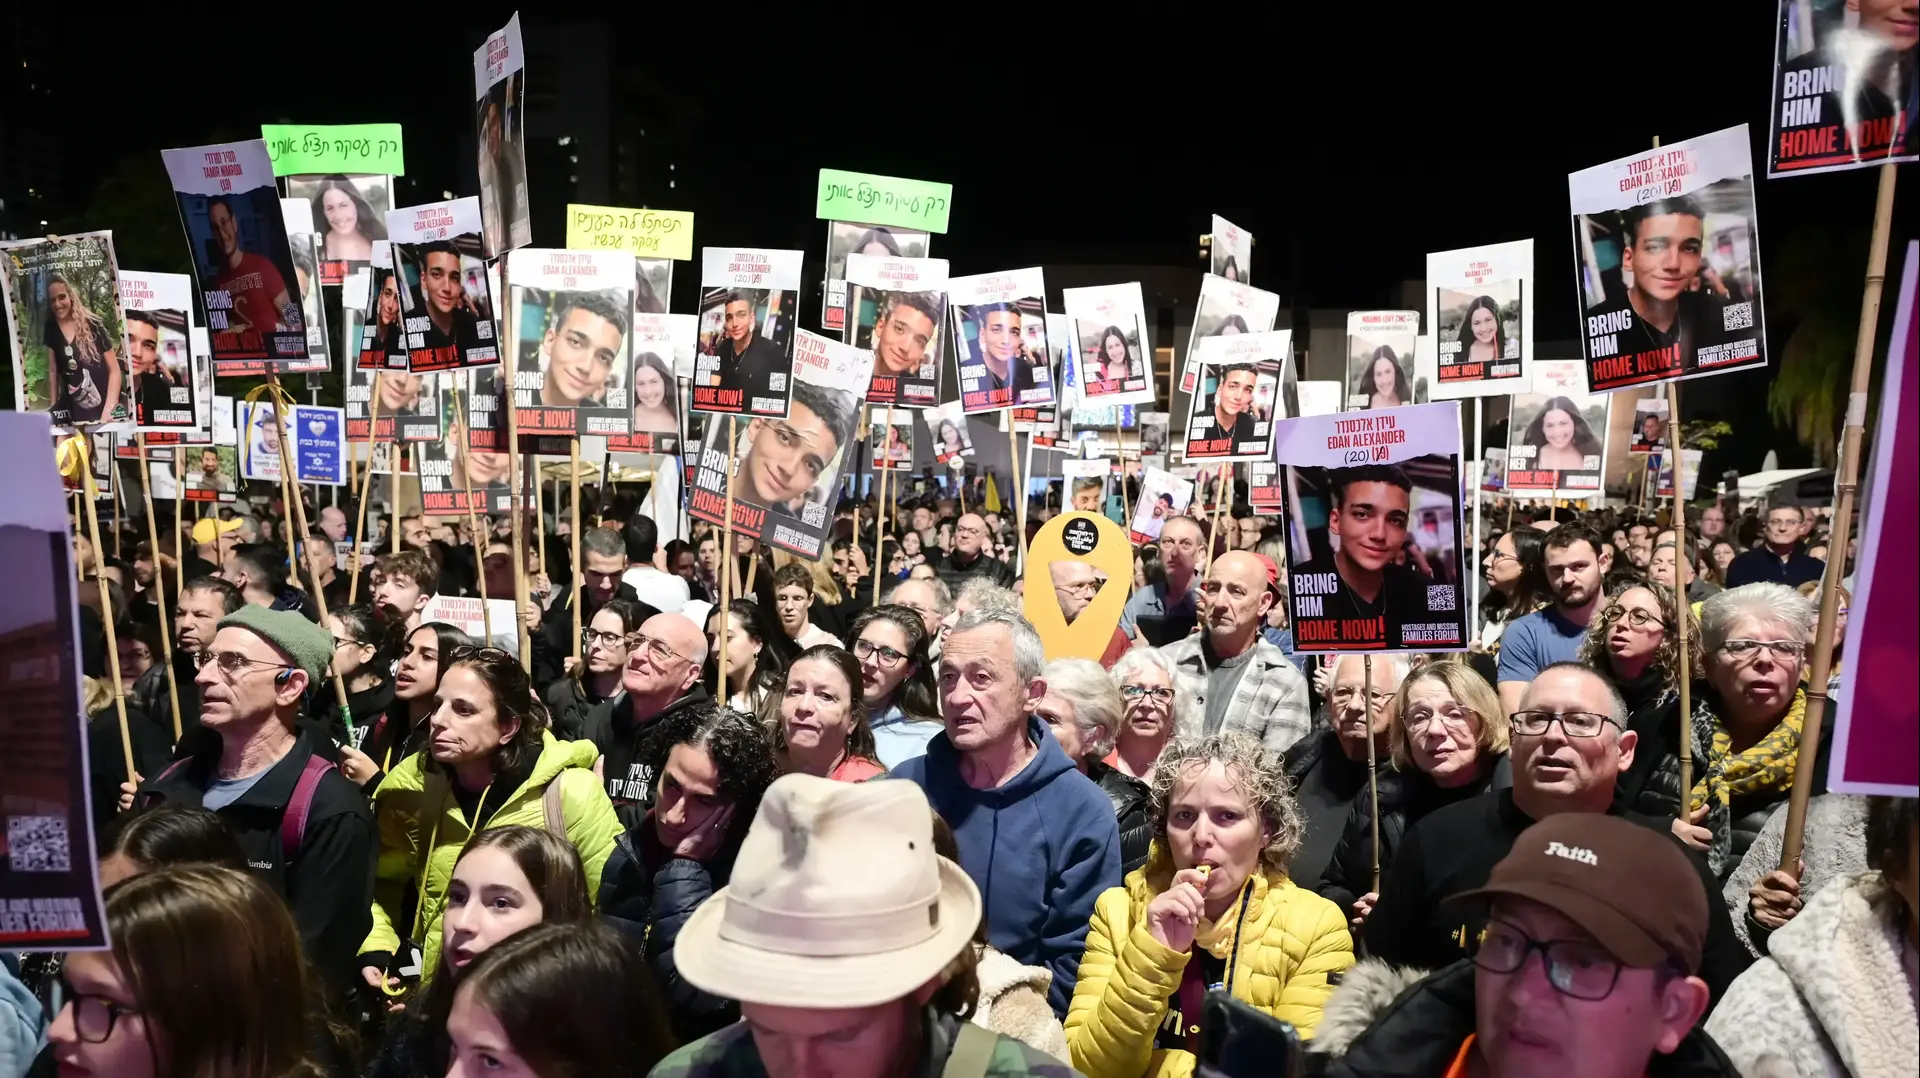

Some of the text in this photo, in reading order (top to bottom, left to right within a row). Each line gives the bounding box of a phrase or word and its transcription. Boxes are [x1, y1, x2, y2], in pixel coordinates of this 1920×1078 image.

[1781, 97, 1822, 128] HIM
[271, 133, 397, 161] רק עסקה תציל אותי
[1780, 126, 1838, 158] HOME
[202, 164, 243, 178] TAMIR NIMRODI
[1627, 155, 1665, 176] אכסנדר
[219, 178, 232, 192] (19)
[1619, 176, 1643, 192] EDAN
[825, 182, 945, 217] רק עסקה תציל אותי
[1636, 185, 1661, 202] (20)
[414, 216, 454, 231] EDAN ALEXANDER
[620, 212, 681, 234] תסתכל לה
[424, 229, 437, 241] (20)
[632, 235, 660, 251] עסקה
[543, 265, 597, 276] EDAN ALEXANDER
[729, 263, 771, 274] EDAN ALEXANDER
[1481, 268, 1493, 276] LEVY
[735, 274, 750, 284] (20)
[205, 290, 233, 309] BRING
[209, 311, 228, 329] HIM
[406, 316, 431, 332] BRING
[1588, 309, 1632, 337] BRING
[408, 334, 425, 349] HIM
[810, 339, 826, 354] עידן
[1440, 341, 1462, 353] BRING
[1590, 333, 1618, 358] HIM
[1698, 344, 1723, 355] HOSTAGES
[1723, 342, 1734, 350] AND
[411, 350, 434, 366] HOME
[436, 344, 459, 363] NOW!
[697, 355, 721, 371] BRING
[796, 349, 830, 370] EXANDER
[1440, 354, 1454, 365] HER
[1593, 343, 1682, 381] HOME NOW!
[1698, 345, 1758, 366] FAMILIES FORUM
[961, 365, 987, 379] BRING
[1440, 366, 1461, 378] HOME
[1462, 361, 1484, 377] NOW!
[513, 371, 543, 389] BRING
[695, 371, 711, 386] HIM
[872, 377, 896, 393] NOW!
[963, 379, 979, 392] HIM
[346, 385, 370, 401] BRING
[695, 388, 716, 403] HOME
[718, 389, 743, 406] NOW!
[964, 391, 988, 406] HOME
[989, 386, 1013, 403] NOW!
[346, 402, 362, 418] HIM
[470, 394, 499, 412] BRING
[347, 420, 369, 436] HOME
[375, 417, 395, 436] OW!
[470, 412, 488, 428] HIM
[544, 409, 576, 428] NOW!
[1335, 416, 1396, 434] עידן אלכסנדר
[1188, 441, 1209, 453] HOME
[1210, 437, 1232, 452] NOW!
[1328, 430, 1405, 449] EDAN ALEXANDER
[1344, 450, 1369, 464] (20)
[1510, 445, 1537, 458] BRING
[420, 460, 452, 476] BRING
[701, 447, 740, 478] BRING
[1509, 458, 1526, 470] HER
[422, 476, 442, 492] HIM
[696, 467, 722, 493] HIM
[1508, 470, 1560, 484] HOME NOW!
[424, 493, 454, 508] HOME
[692, 488, 766, 531] HOME NOW!
[1294, 573, 1338, 594] BRING
[1296, 596, 1324, 617] HIM
[434, 609, 485, 622] EDAN ALEXANDE
[1298, 616, 1386, 641] HOME NOW!
[1402, 630, 1460, 641] FAMILIES FORUM
[1544, 841, 1598, 866] Faith
[247, 858, 272, 869] lumbia
[27, 912, 87, 932] FORUM
